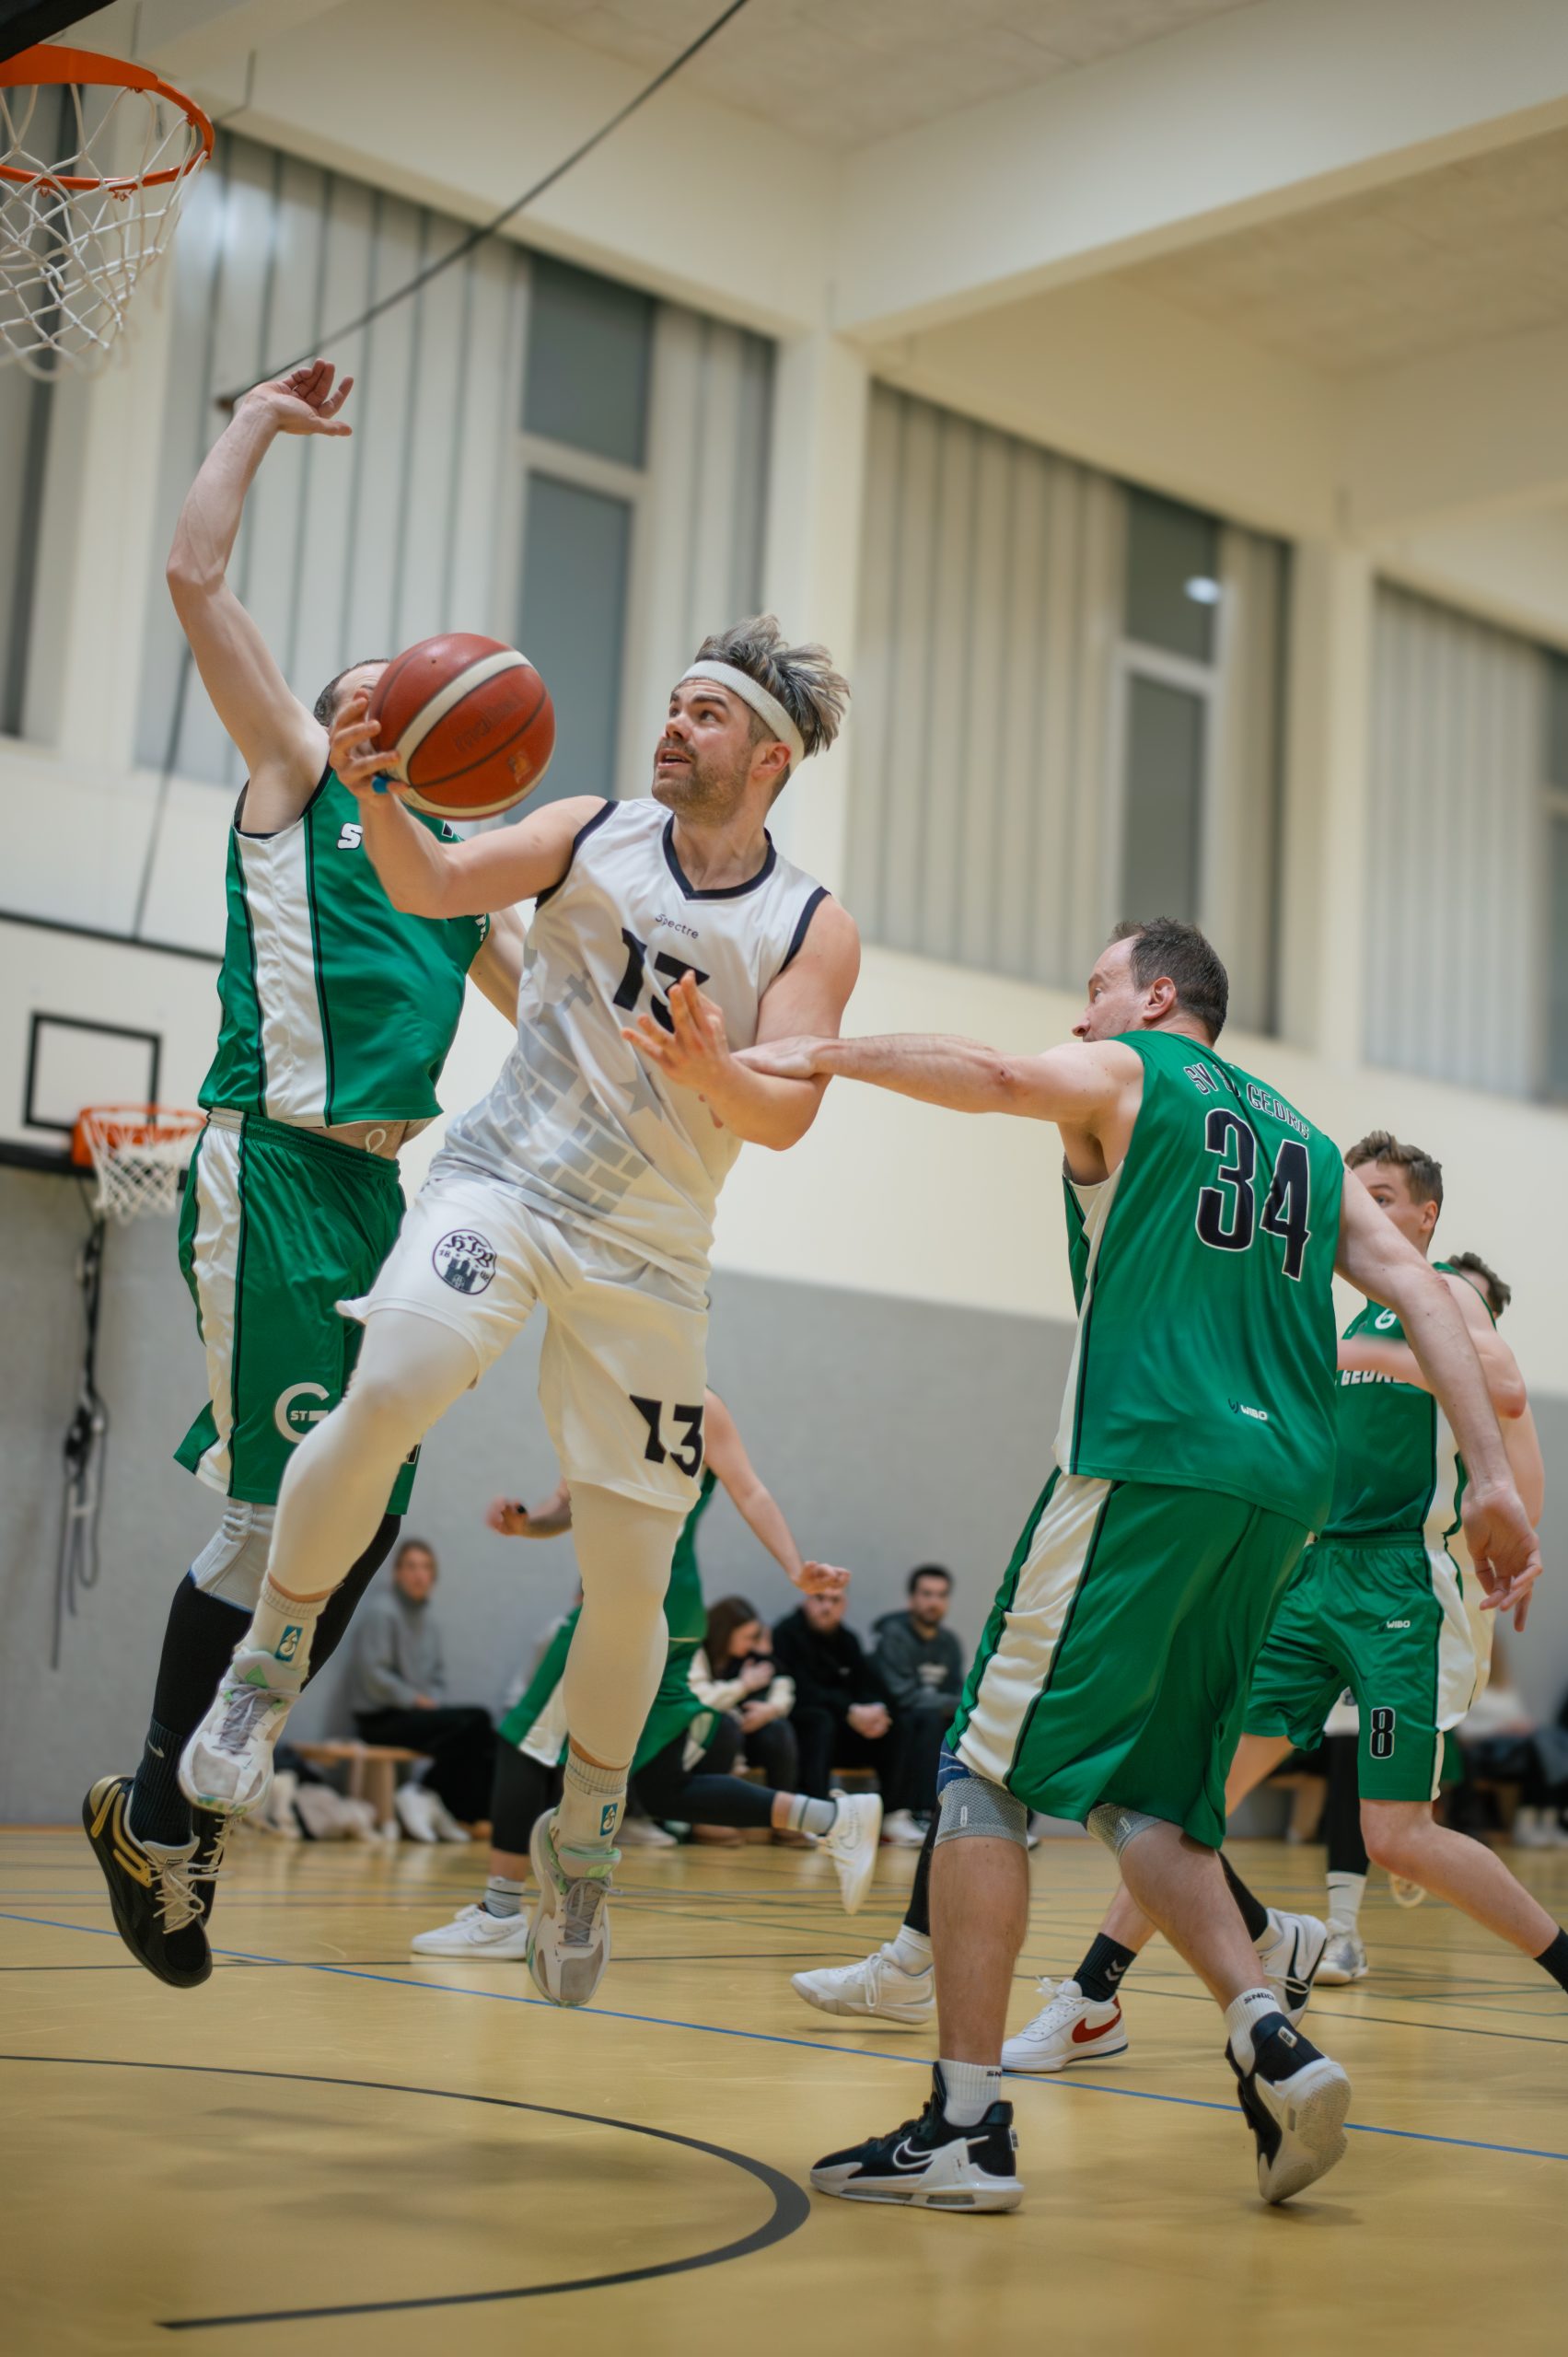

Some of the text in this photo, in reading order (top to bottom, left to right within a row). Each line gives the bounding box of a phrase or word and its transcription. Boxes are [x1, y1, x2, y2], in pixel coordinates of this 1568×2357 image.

[655, 913, 700, 939] Spectre
[612, 927, 710, 1035] 13
[1183, 1062, 1220, 1096] SV
[1246, 1082, 1309, 1141] GEORG
[1194, 1108, 1312, 1283] 34
[439, 1248, 451, 1259] 18
[290, 1410, 308, 1422] ST
[1239, 1403, 1269, 1421] WIBO
[629, 1393, 704, 1479] 13
[1386, 1620, 1411, 1629] WIBO
[1369, 1706, 1396, 1759] 8
